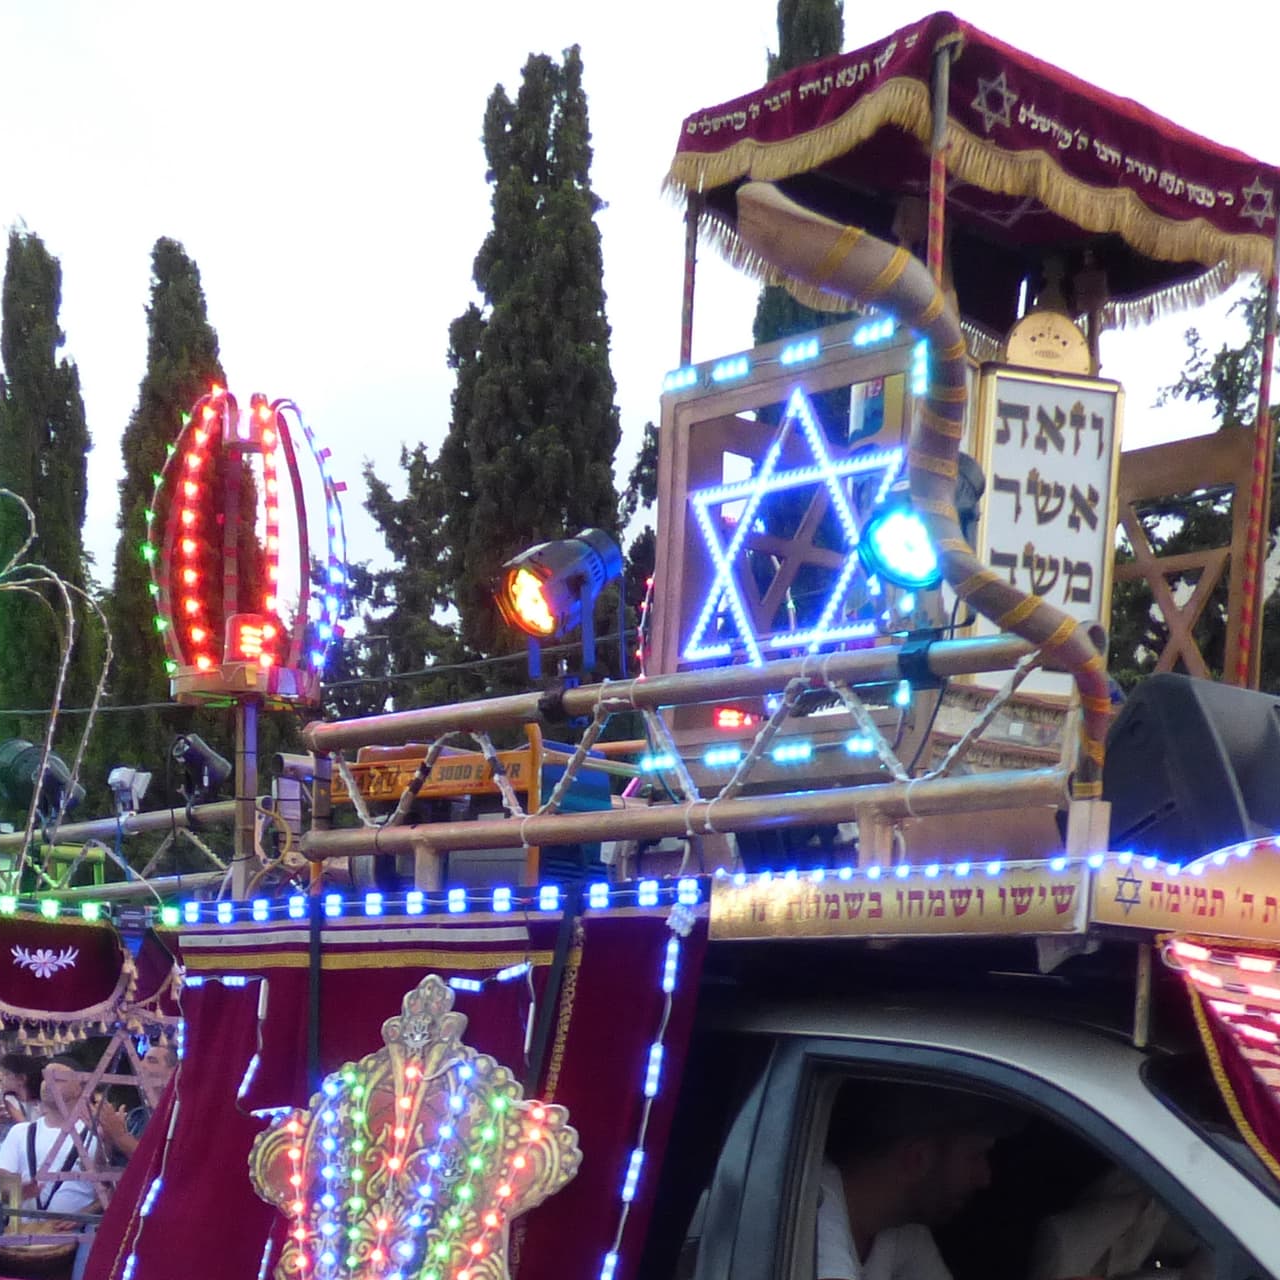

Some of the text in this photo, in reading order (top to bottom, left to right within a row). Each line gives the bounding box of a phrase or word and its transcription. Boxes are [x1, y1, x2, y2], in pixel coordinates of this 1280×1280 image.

[799, 76, 833, 100] תורה
[1125, 155, 1158, 183] תורה
[1158, 170, 1185, 196] תצא
[1217, 190, 1234, 206] כי
[995, 400, 1104, 460] וזאת
[993, 467, 1099, 533] אשר
[896, 887, 984, 918] ושמחו
[998, 885, 1076, 916] שישו
[1149, 881, 1225, 918] תמימה
